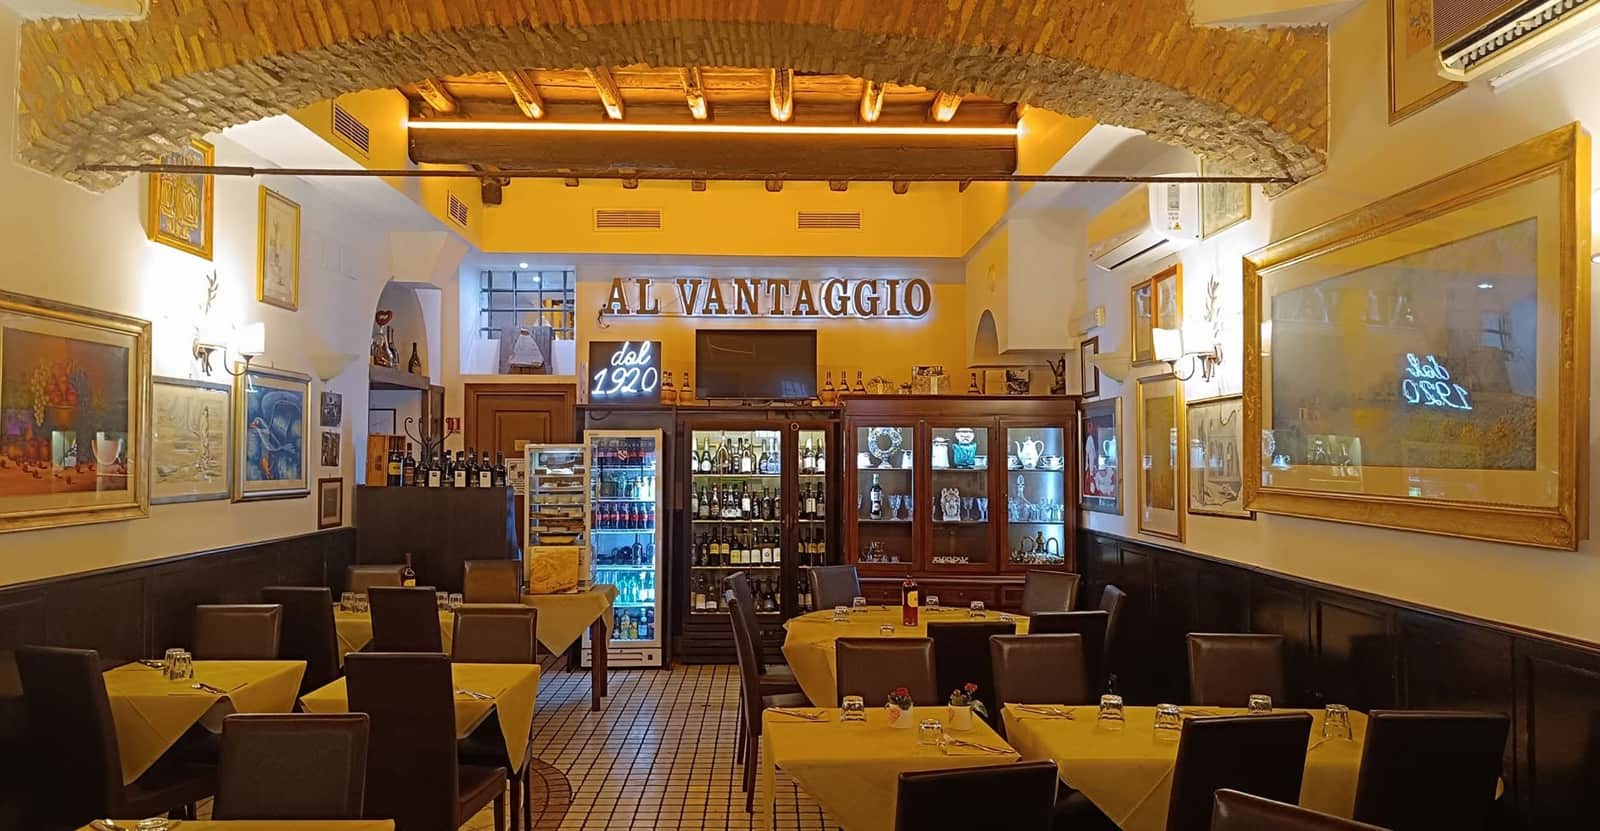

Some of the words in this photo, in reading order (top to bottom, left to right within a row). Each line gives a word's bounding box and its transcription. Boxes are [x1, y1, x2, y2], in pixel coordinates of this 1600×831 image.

[604, 277, 660, 315] AL
[675, 278, 932, 317] VANTAGGIO
[591, 367, 658, 395] 1920
